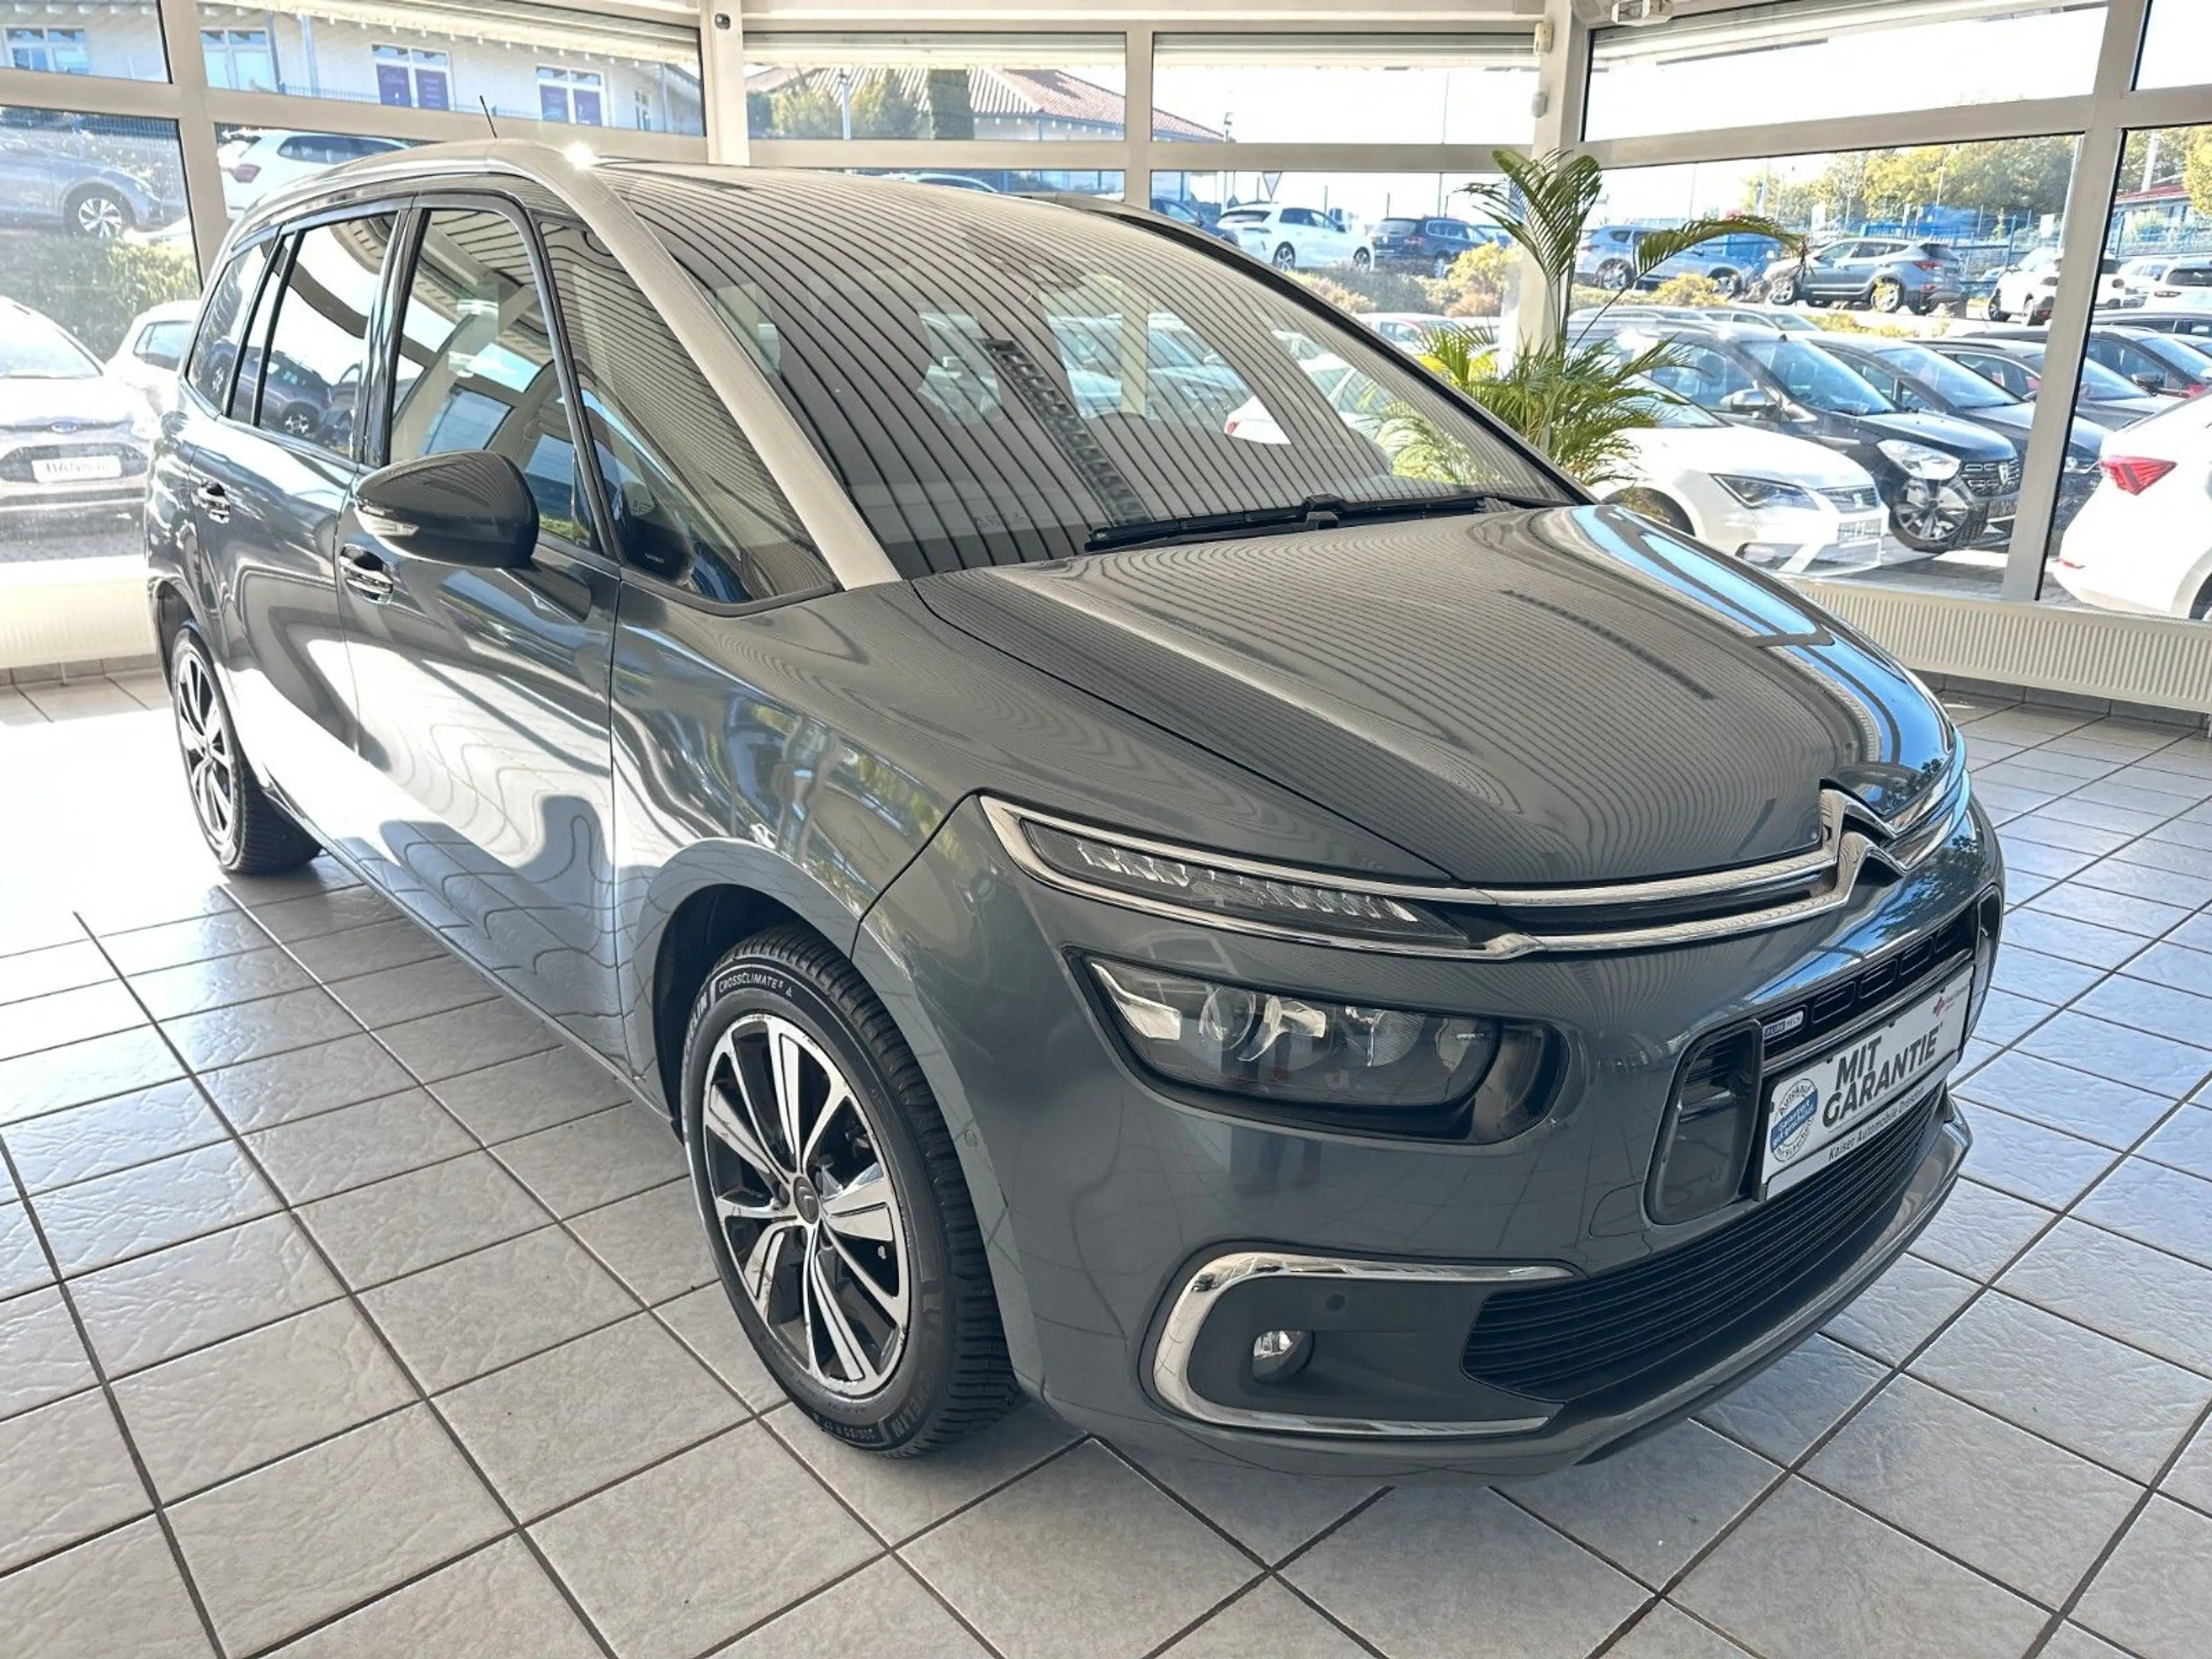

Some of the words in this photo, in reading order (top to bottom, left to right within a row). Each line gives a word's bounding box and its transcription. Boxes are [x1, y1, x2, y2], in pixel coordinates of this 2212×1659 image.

[1822, 1024, 1940, 1128] GARANTIE
[1835, 1035, 1883, 1092] MIT
[1828, 1137, 1855, 1161] Kaiser
